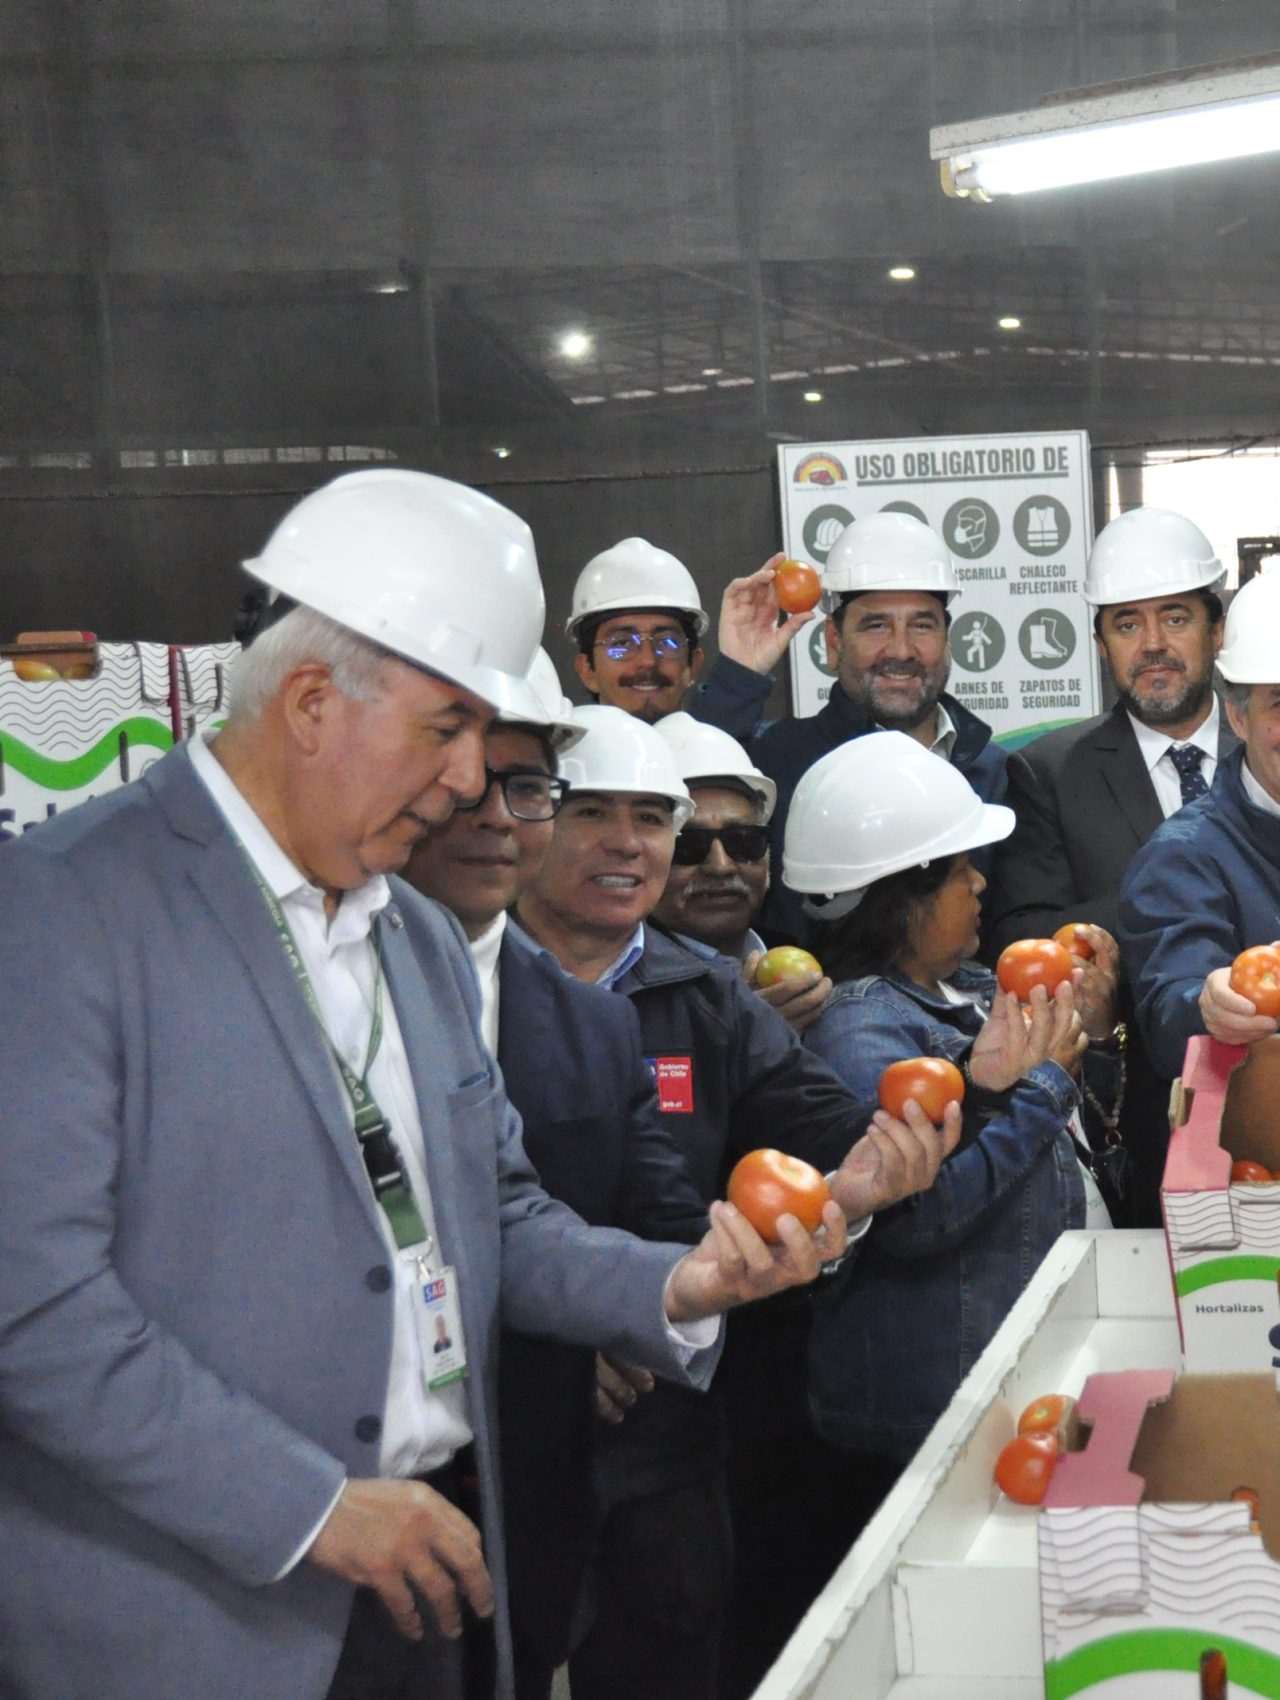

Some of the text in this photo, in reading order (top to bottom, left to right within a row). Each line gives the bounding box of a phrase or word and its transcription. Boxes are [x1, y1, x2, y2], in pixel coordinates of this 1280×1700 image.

[855, 454, 896, 480] USO
[903, 447, 1036, 478] OBLIGATORIO
[1043, 446, 1070, 471] DE
[955, 566, 1007, 580] SCARILLA
[1019, 565, 1067, 579] CHALECO
[1009, 580, 1079, 596] REFLECTANTE
[954, 681, 1004, 695] ARNES DE
[1019, 678, 1082, 693] ZAPATOS DE
[957, 697, 1009, 710] GURIDAD
[1022, 694, 1081, 709] SEGURIDAD
[1195, 1303, 1264, 1315] Hortalizas
